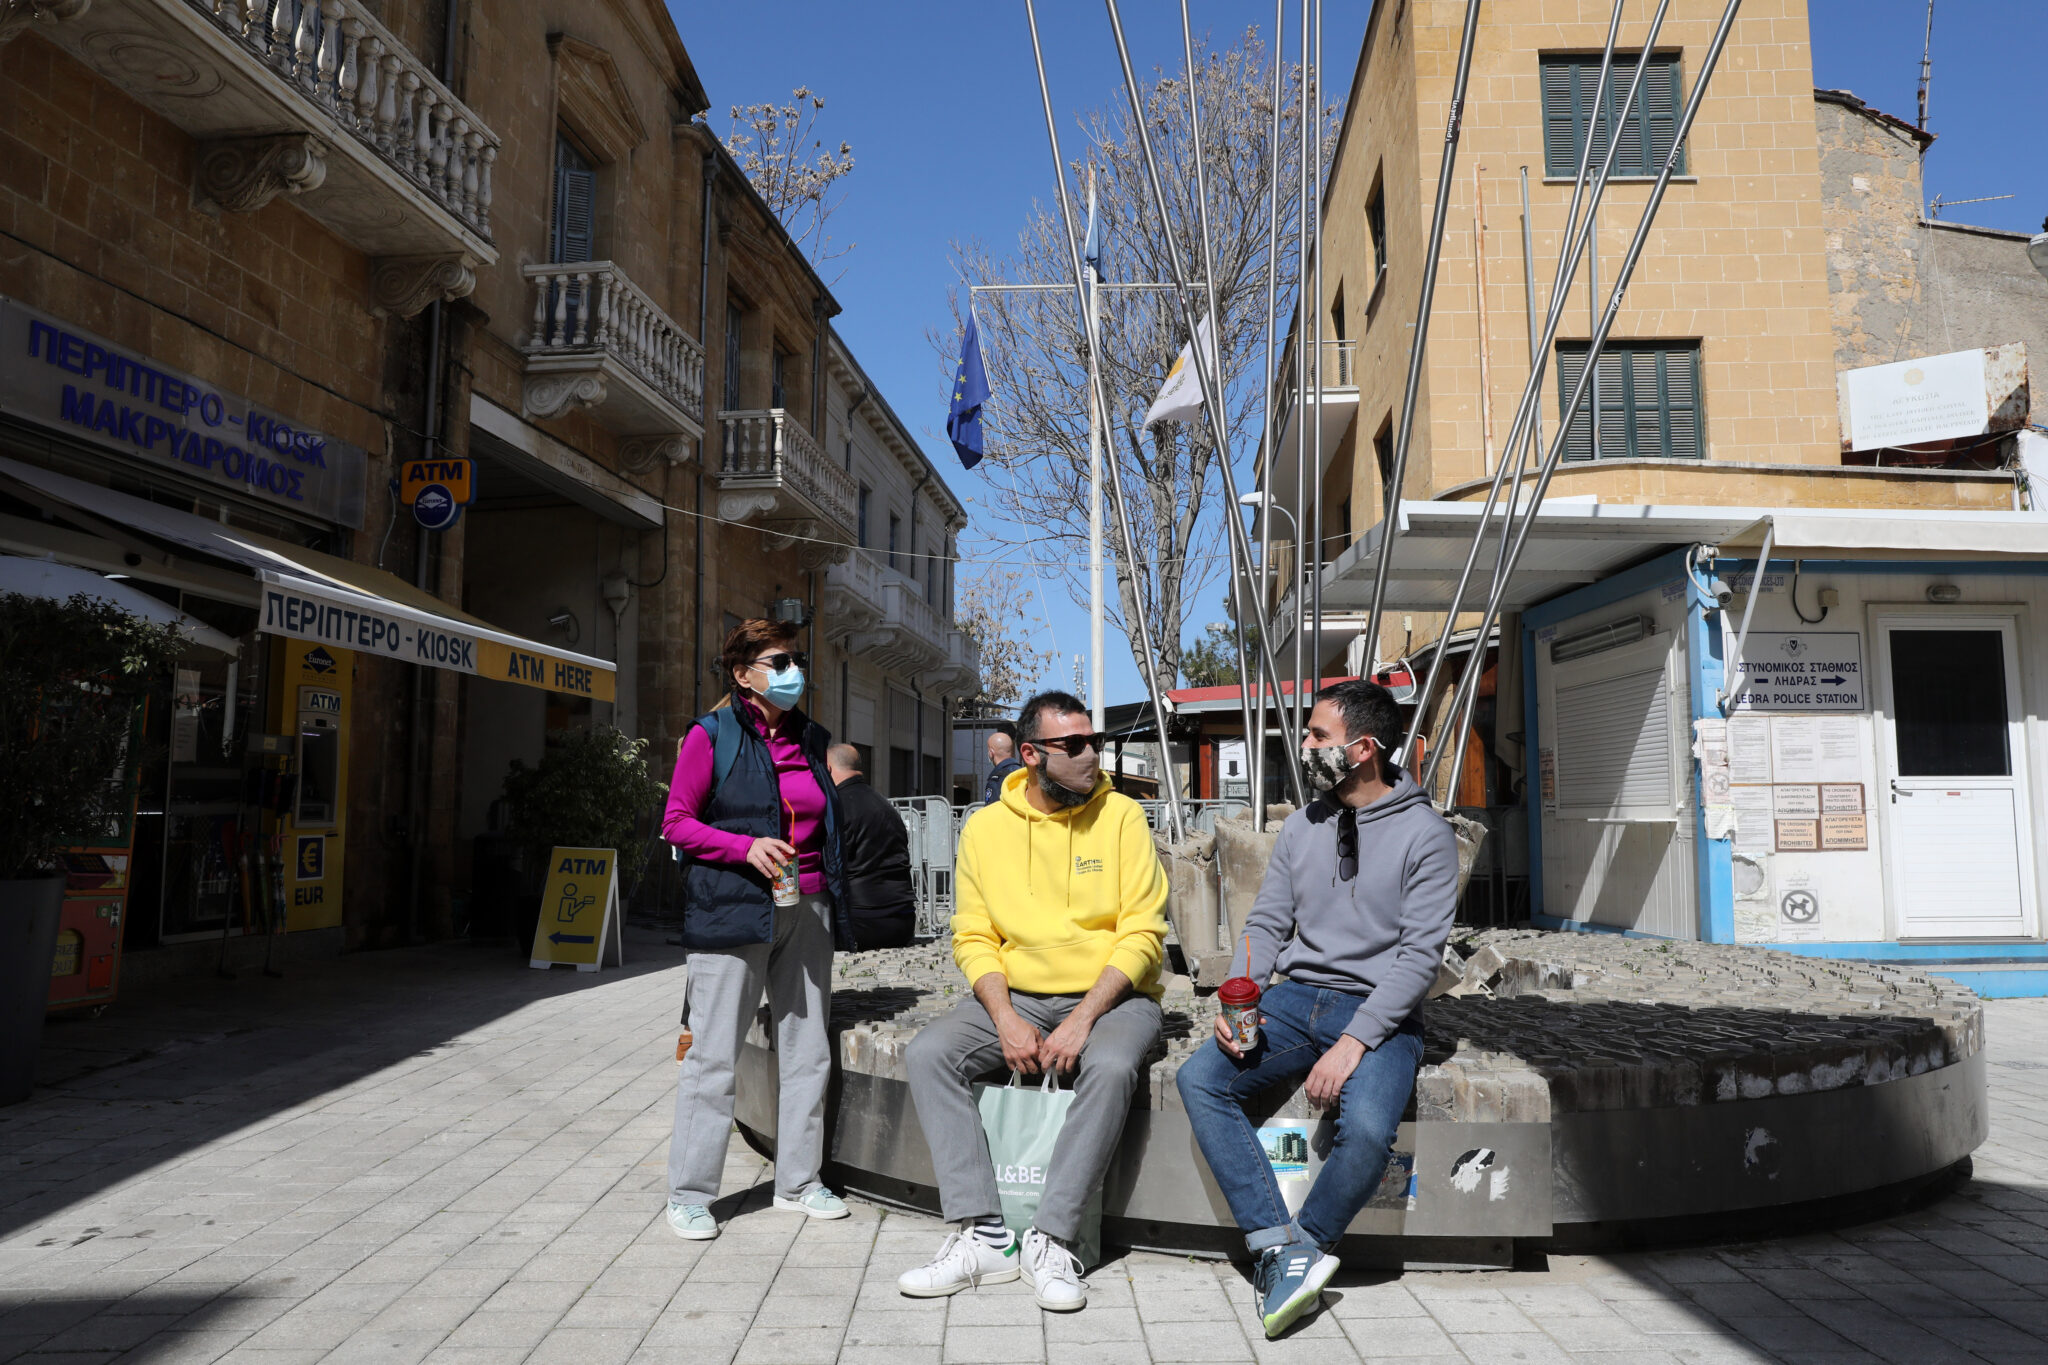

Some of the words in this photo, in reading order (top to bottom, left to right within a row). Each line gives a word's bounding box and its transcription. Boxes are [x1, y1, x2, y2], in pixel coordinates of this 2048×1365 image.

[28, 319, 225, 427] ΠΕΡΙΠΤΕΡΟ
[248, 411, 327, 469] KIOSK
[61, 384, 304, 500] ΜΑΚΡΥΔΡΟΜΟΣ
[408, 460, 464, 482] ATM
[266, 591, 401, 652] ΠΕΡΙΠΤΕΡΟ
[417, 629, 473, 669] KIOSK
[507, 652, 545, 684] ATM
[554, 661, 593, 694] HERE
[1809, 662, 1858, 673] ΣΤΑΘΜΟΣ
[1774, 676, 1817, 686] ΛΗΔΡΑΣ
[310, 693, 341, 711] ATM
[1735, 693, 1770, 704] LEDRA
[1773, 693, 1811, 704] POLICE
[1815, 693, 1858, 704] STATION
[558, 858, 606, 876] ATM
[294, 886, 324, 906] EUR
[996, 1163, 1048, 1185] L&BE
